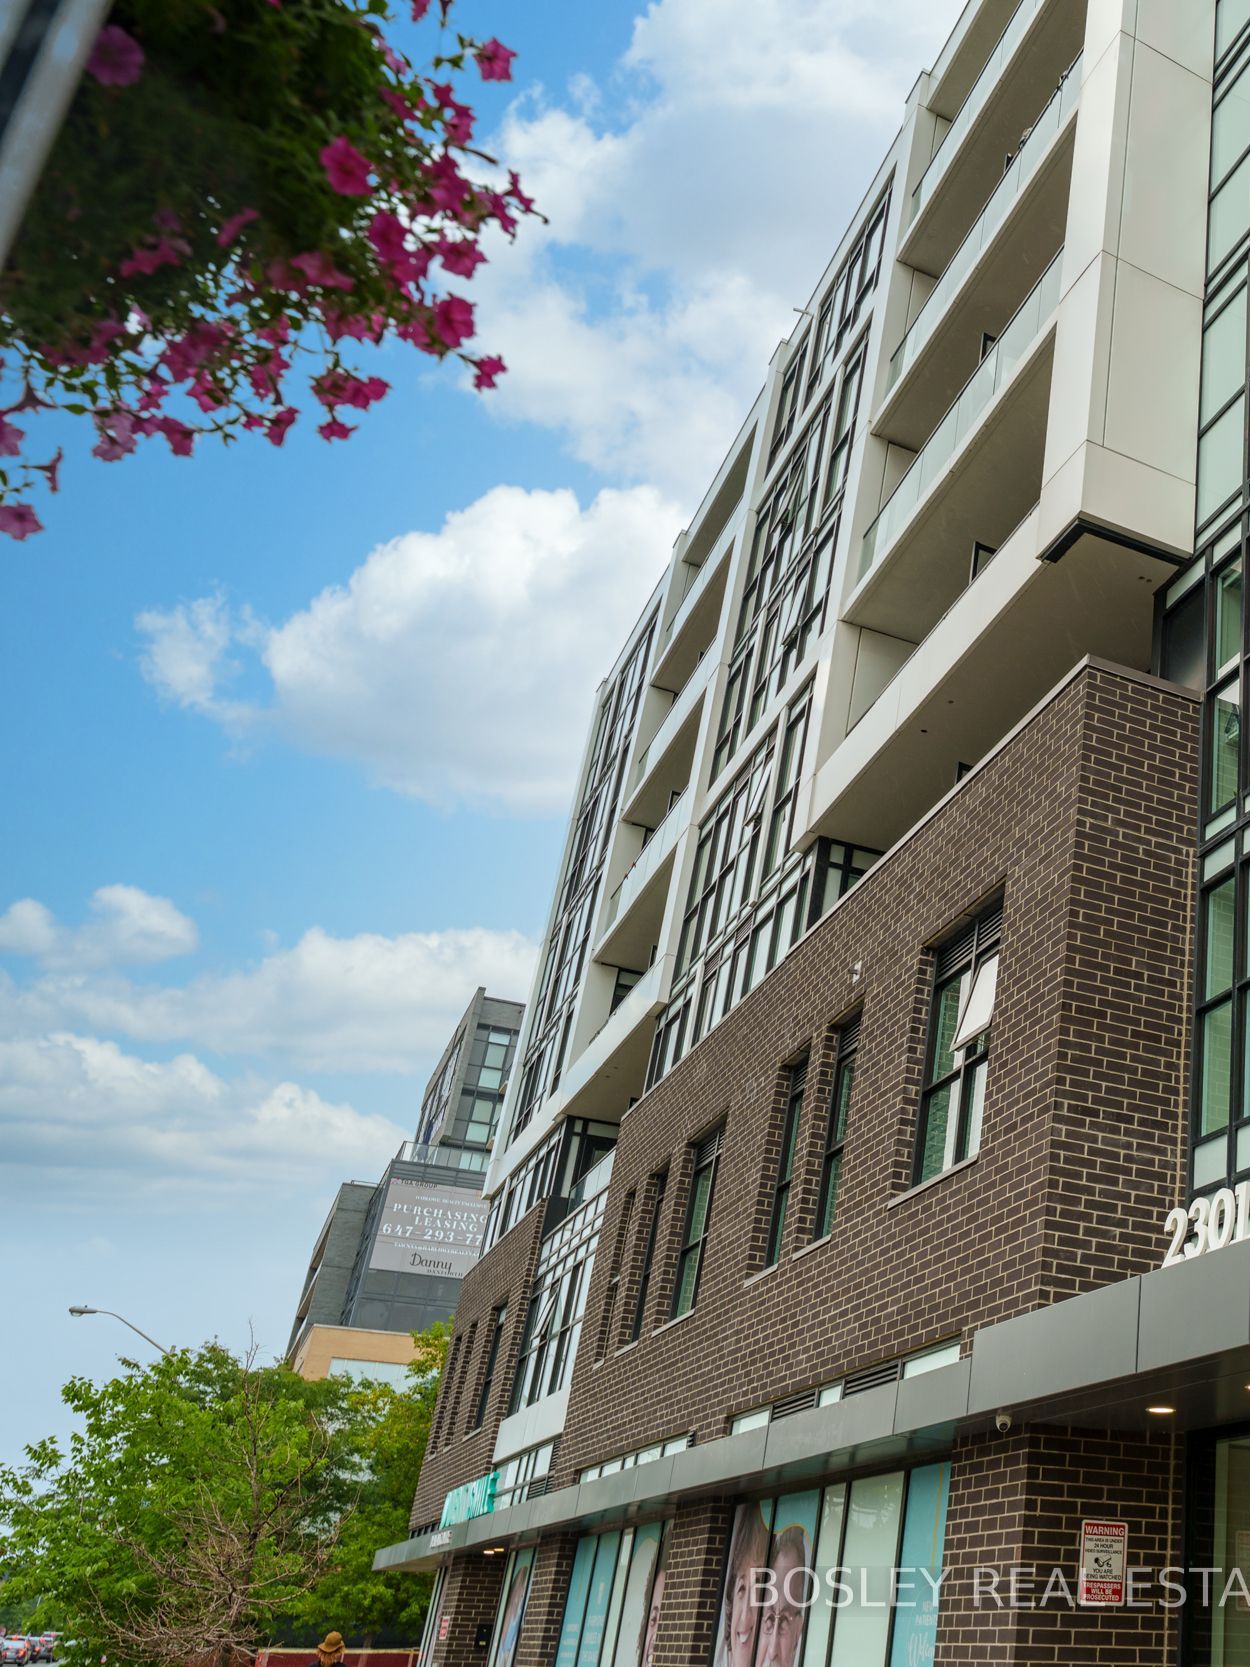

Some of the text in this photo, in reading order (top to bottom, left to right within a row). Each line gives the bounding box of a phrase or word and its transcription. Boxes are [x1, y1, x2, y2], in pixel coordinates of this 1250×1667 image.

[414, 1216, 478, 1232] LEASING
[1161, 1181, 1250, 1269] 2301
[410, 1252, 453, 1274] Danny
[1085, 1525, 1125, 1536] WARNING
[1083, 1581, 1122, 1589] TRESPASSERS
